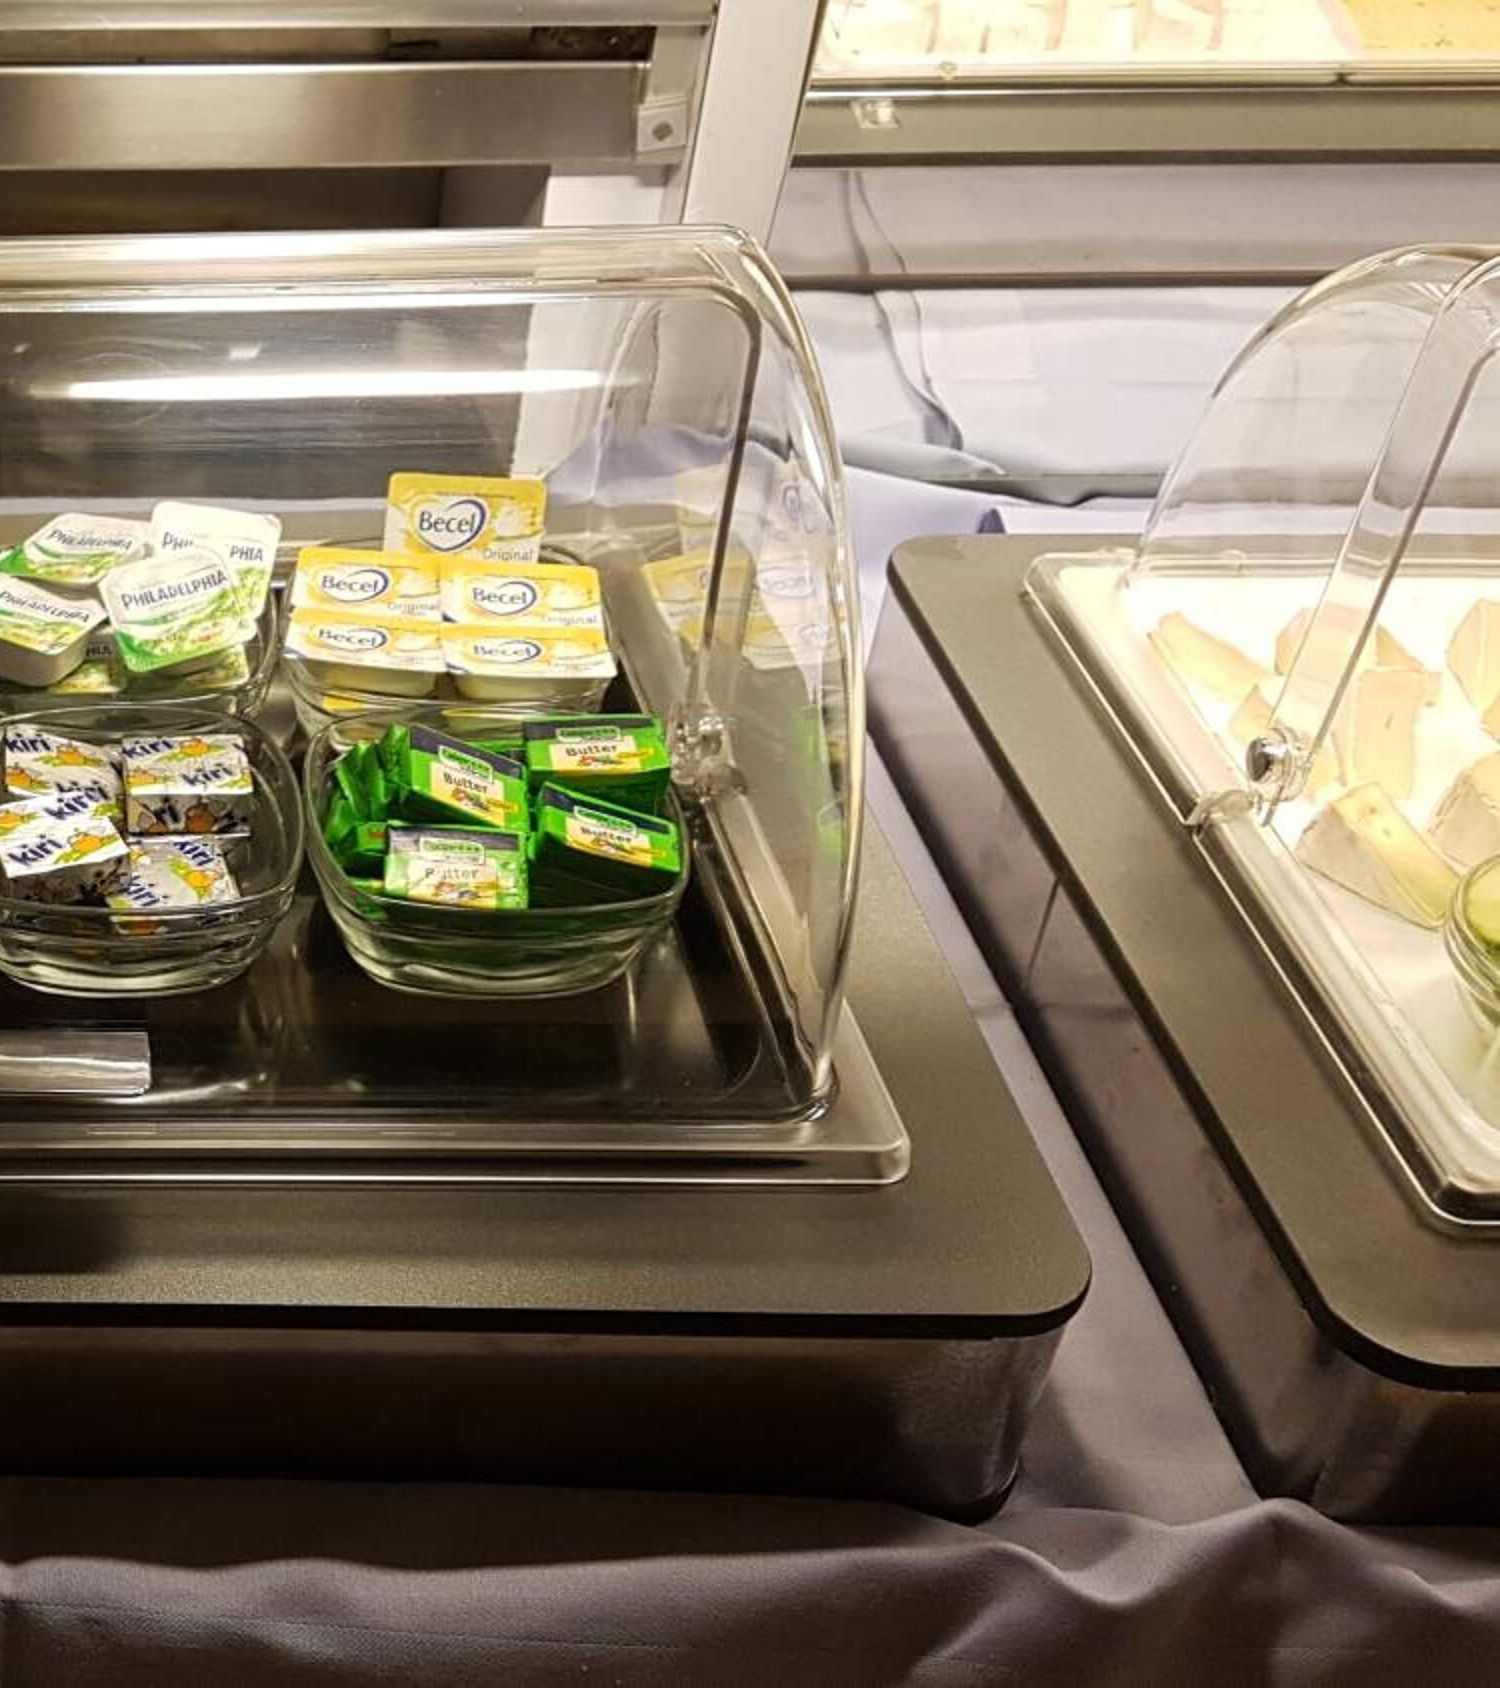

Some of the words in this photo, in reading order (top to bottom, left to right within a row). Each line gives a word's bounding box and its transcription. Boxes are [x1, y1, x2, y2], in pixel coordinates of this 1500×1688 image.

[418, 508, 477, 533] Becel
[481, 547, 534, 563] Original
[120, 568, 229, 609] PHILADELPHIA
[321, 574, 379, 594] Becel
[472, 586, 528, 605] Becel
[4, 733, 52, 753] kiri
[122, 738, 175, 760] kiri
[565, 743, 619, 758] Butter
[181, 763, 233, 787] kiri
[443, 771, 489, 796] Butter
[7, 834, 65, 867] kiri
